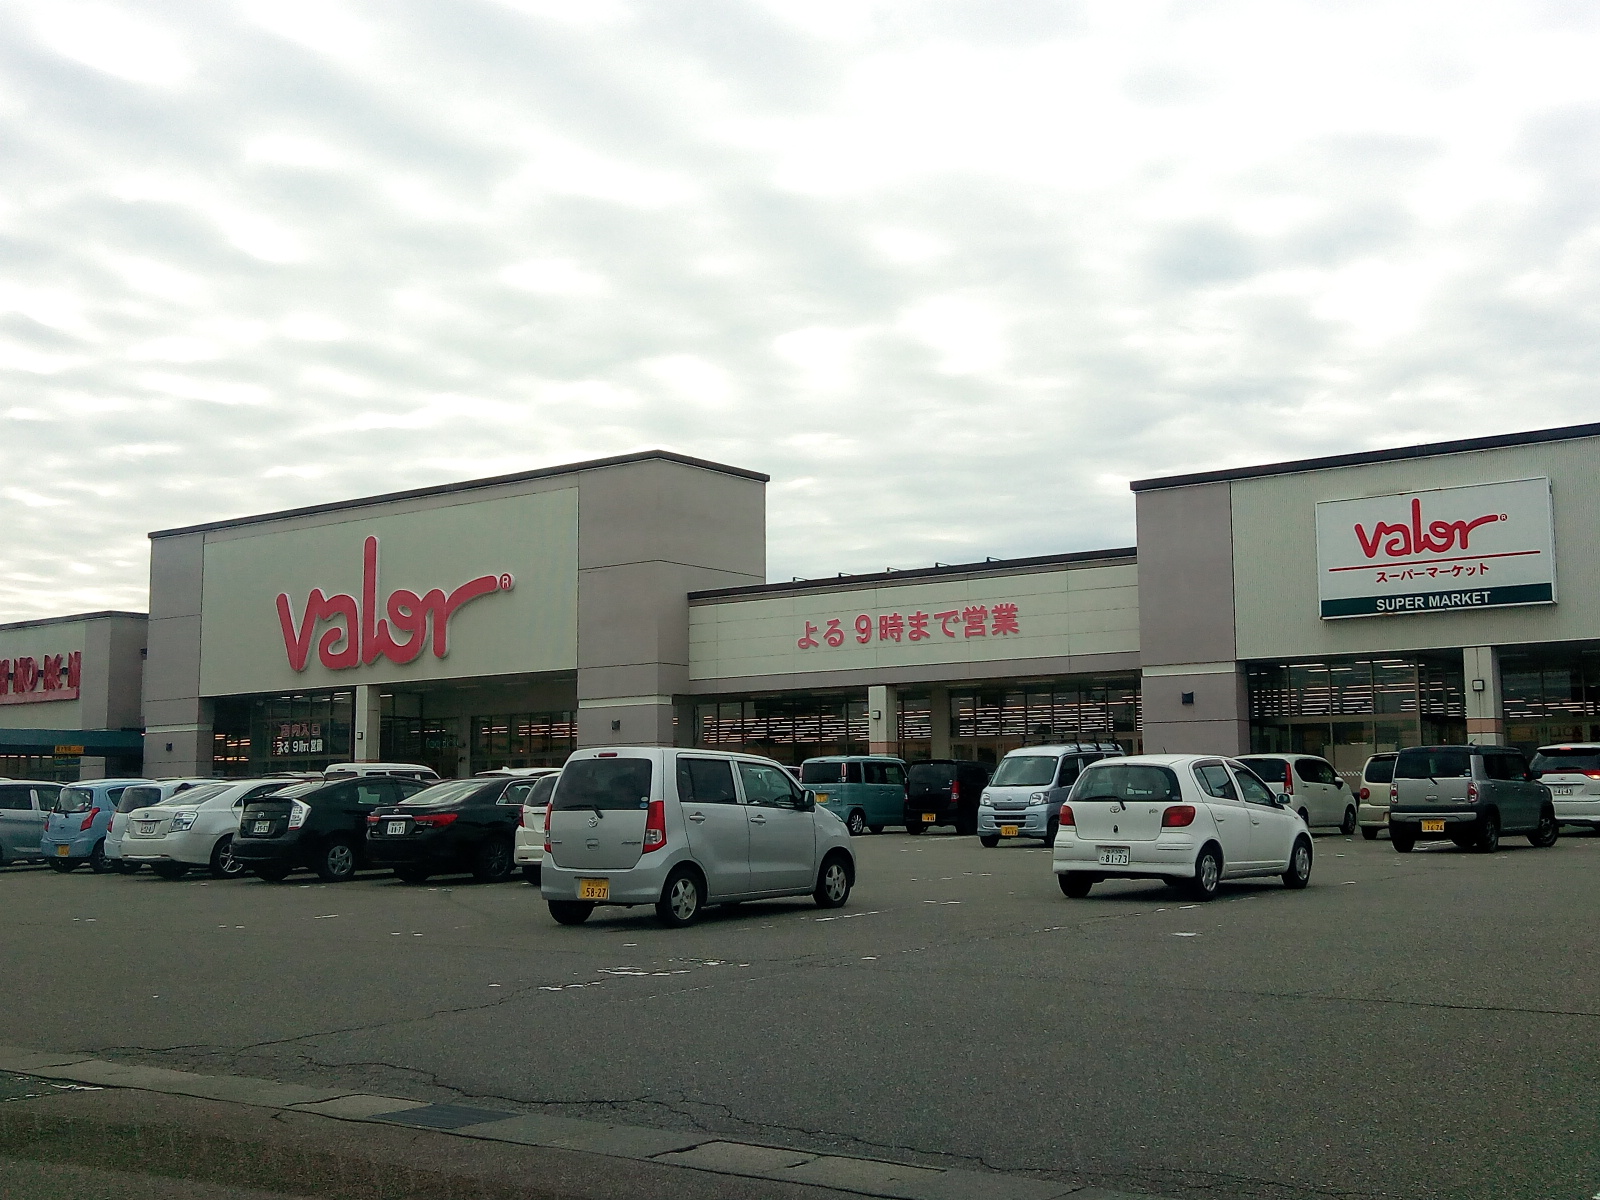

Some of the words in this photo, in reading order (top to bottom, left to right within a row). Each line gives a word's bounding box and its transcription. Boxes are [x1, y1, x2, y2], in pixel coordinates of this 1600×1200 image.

[1376, 562, 1489, 583] スーパーマーケット
[1376, 596, 1425, 611] SUPER
[1429, 591, 1491, 608] MARKET
[797, 603, 1020, 650] よる9時まで営業
[1105, 854, 1128, 864] 81-73
[586, 887, 606, 898] 58-27
